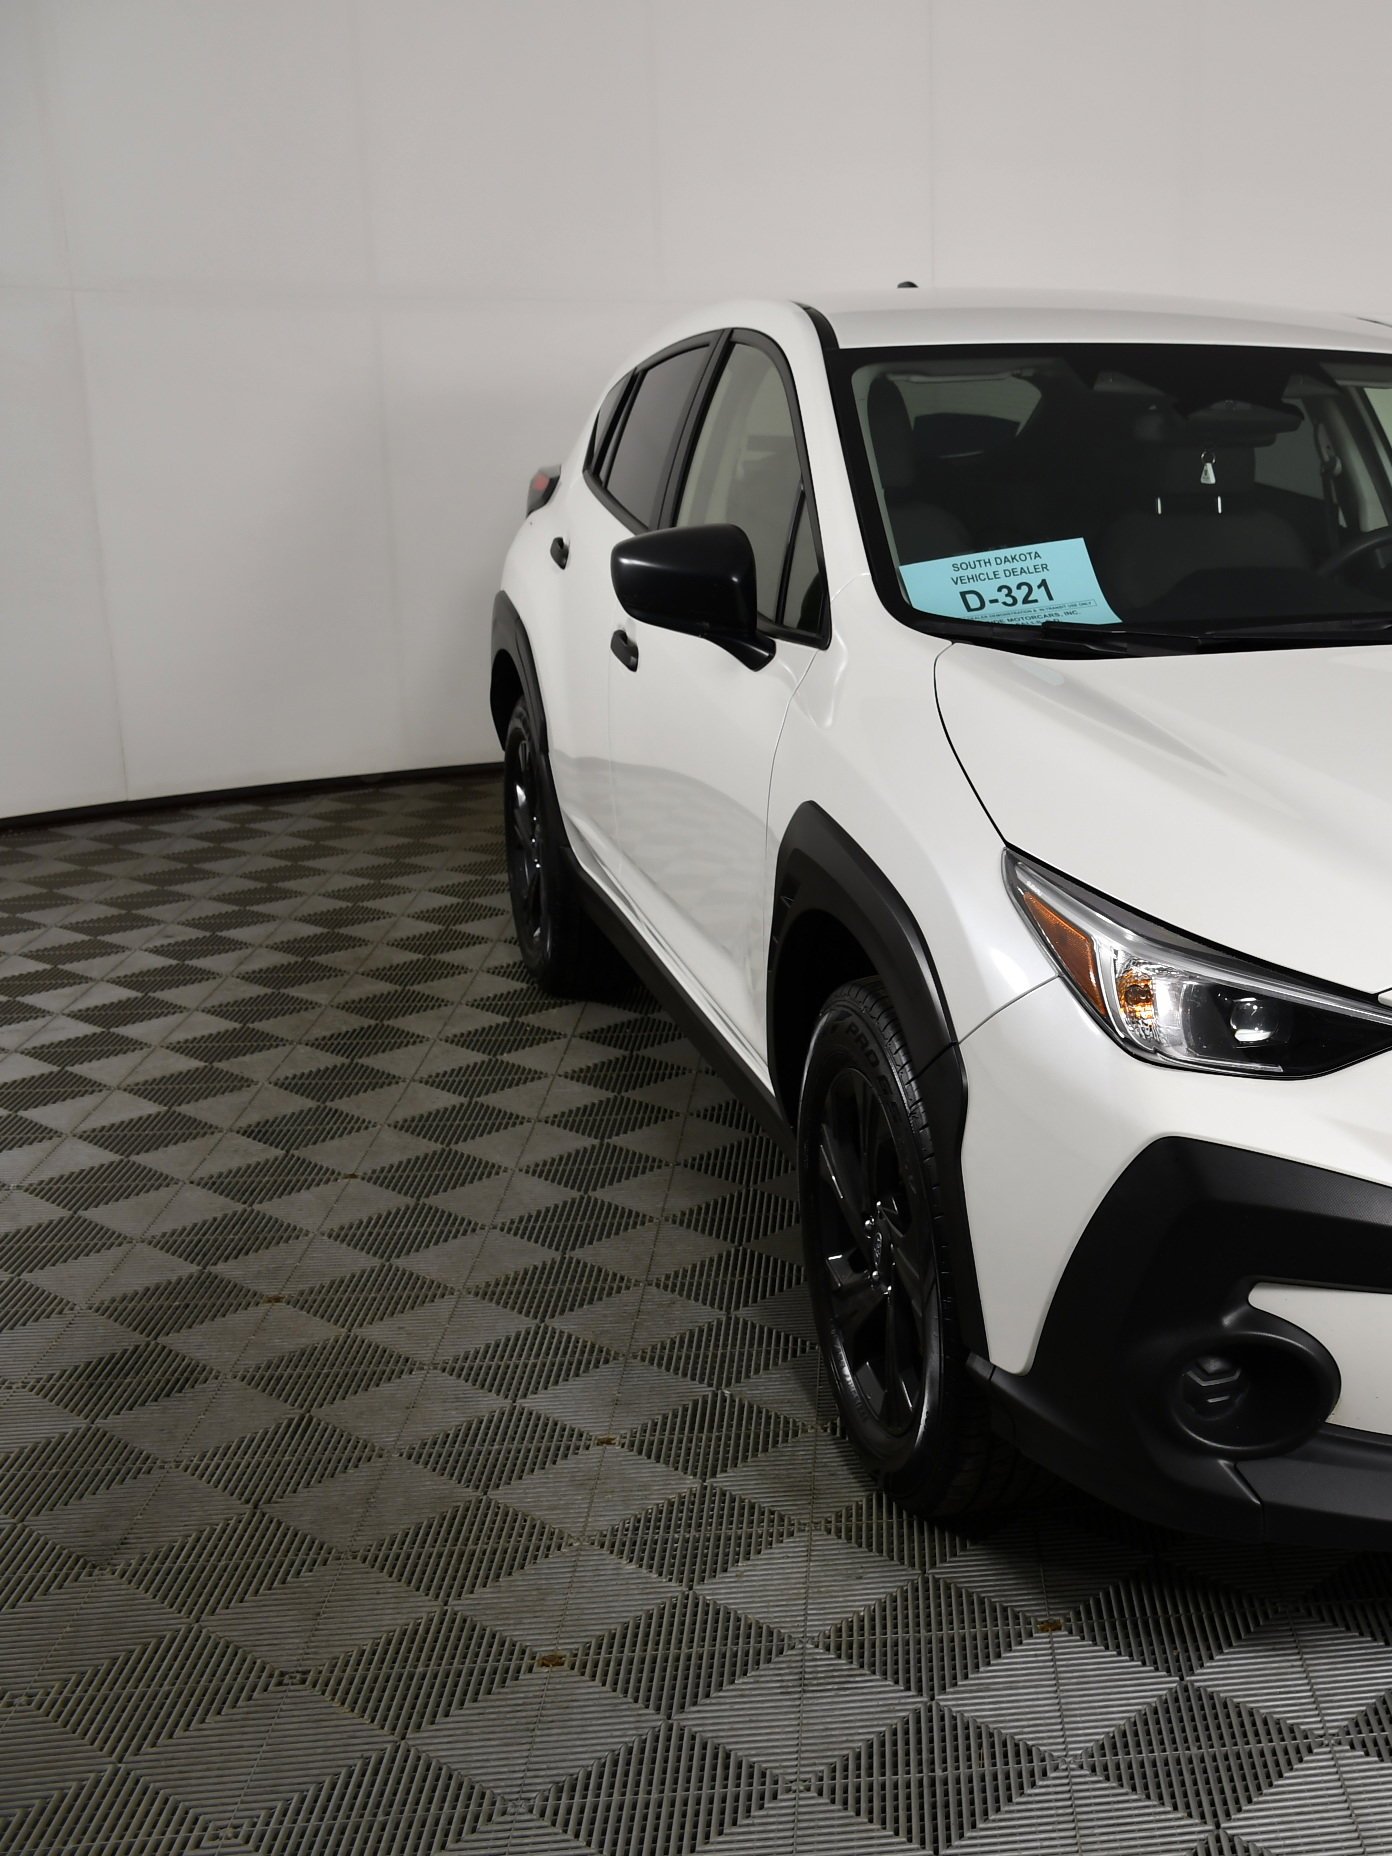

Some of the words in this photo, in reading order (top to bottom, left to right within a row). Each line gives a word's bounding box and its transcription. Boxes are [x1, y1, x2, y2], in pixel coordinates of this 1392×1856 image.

[952, 558, 992, 572] SOUTH
[995, 550, 1042, 566] DAKOTA
[950, 570, 1001, 586] VEHICLE
[1003, 563, 1050, 578] DEALER
[959, 578, 1055, 613] D-321
